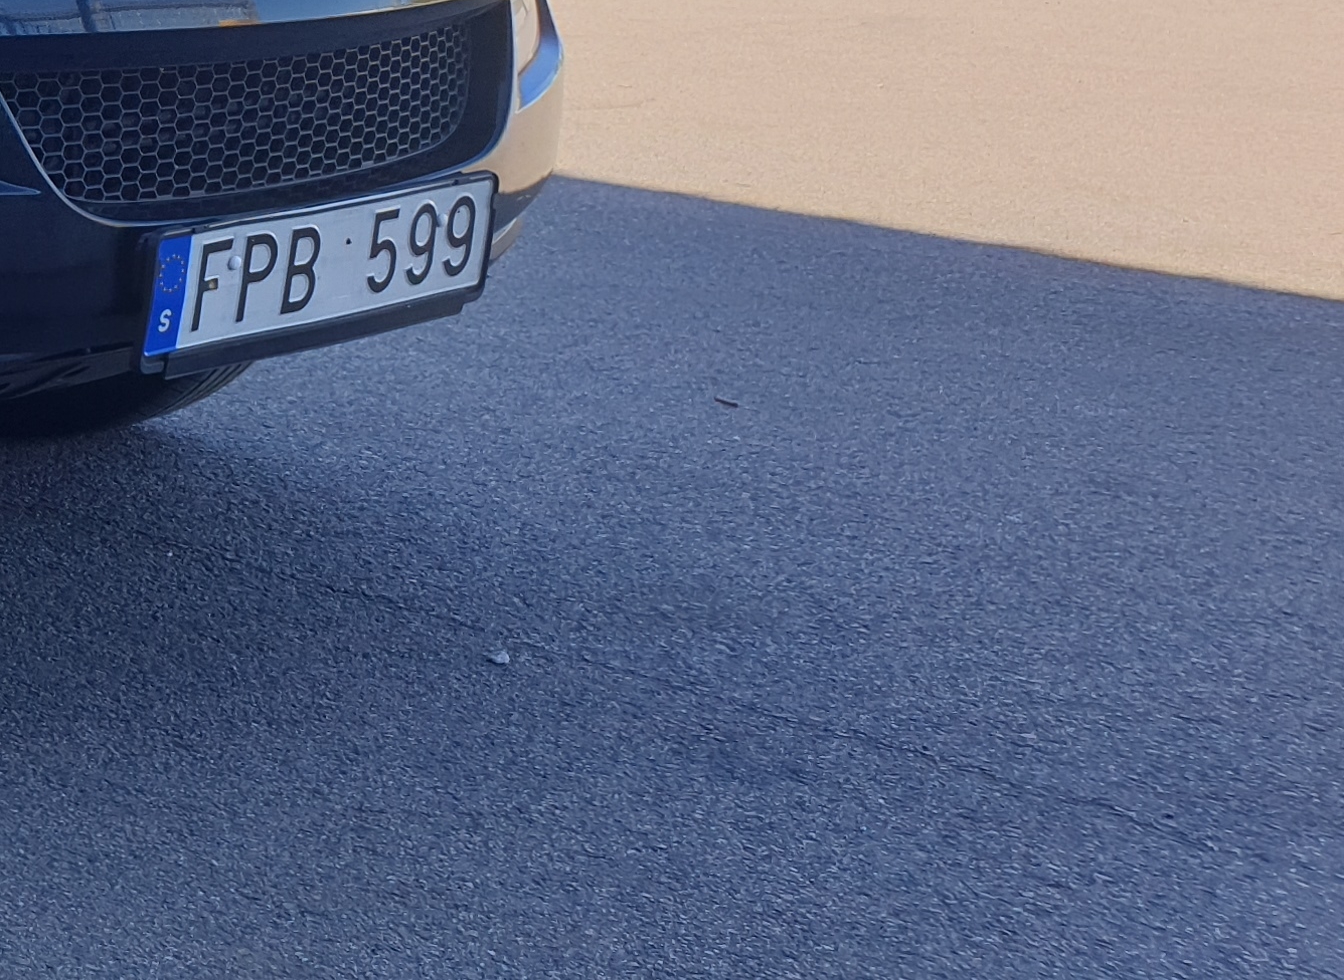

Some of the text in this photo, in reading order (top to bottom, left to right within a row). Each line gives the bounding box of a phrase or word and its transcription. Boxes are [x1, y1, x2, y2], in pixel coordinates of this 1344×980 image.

[190, 195, 476, 332] FPB 599
[158, 309, 172, 332] S
